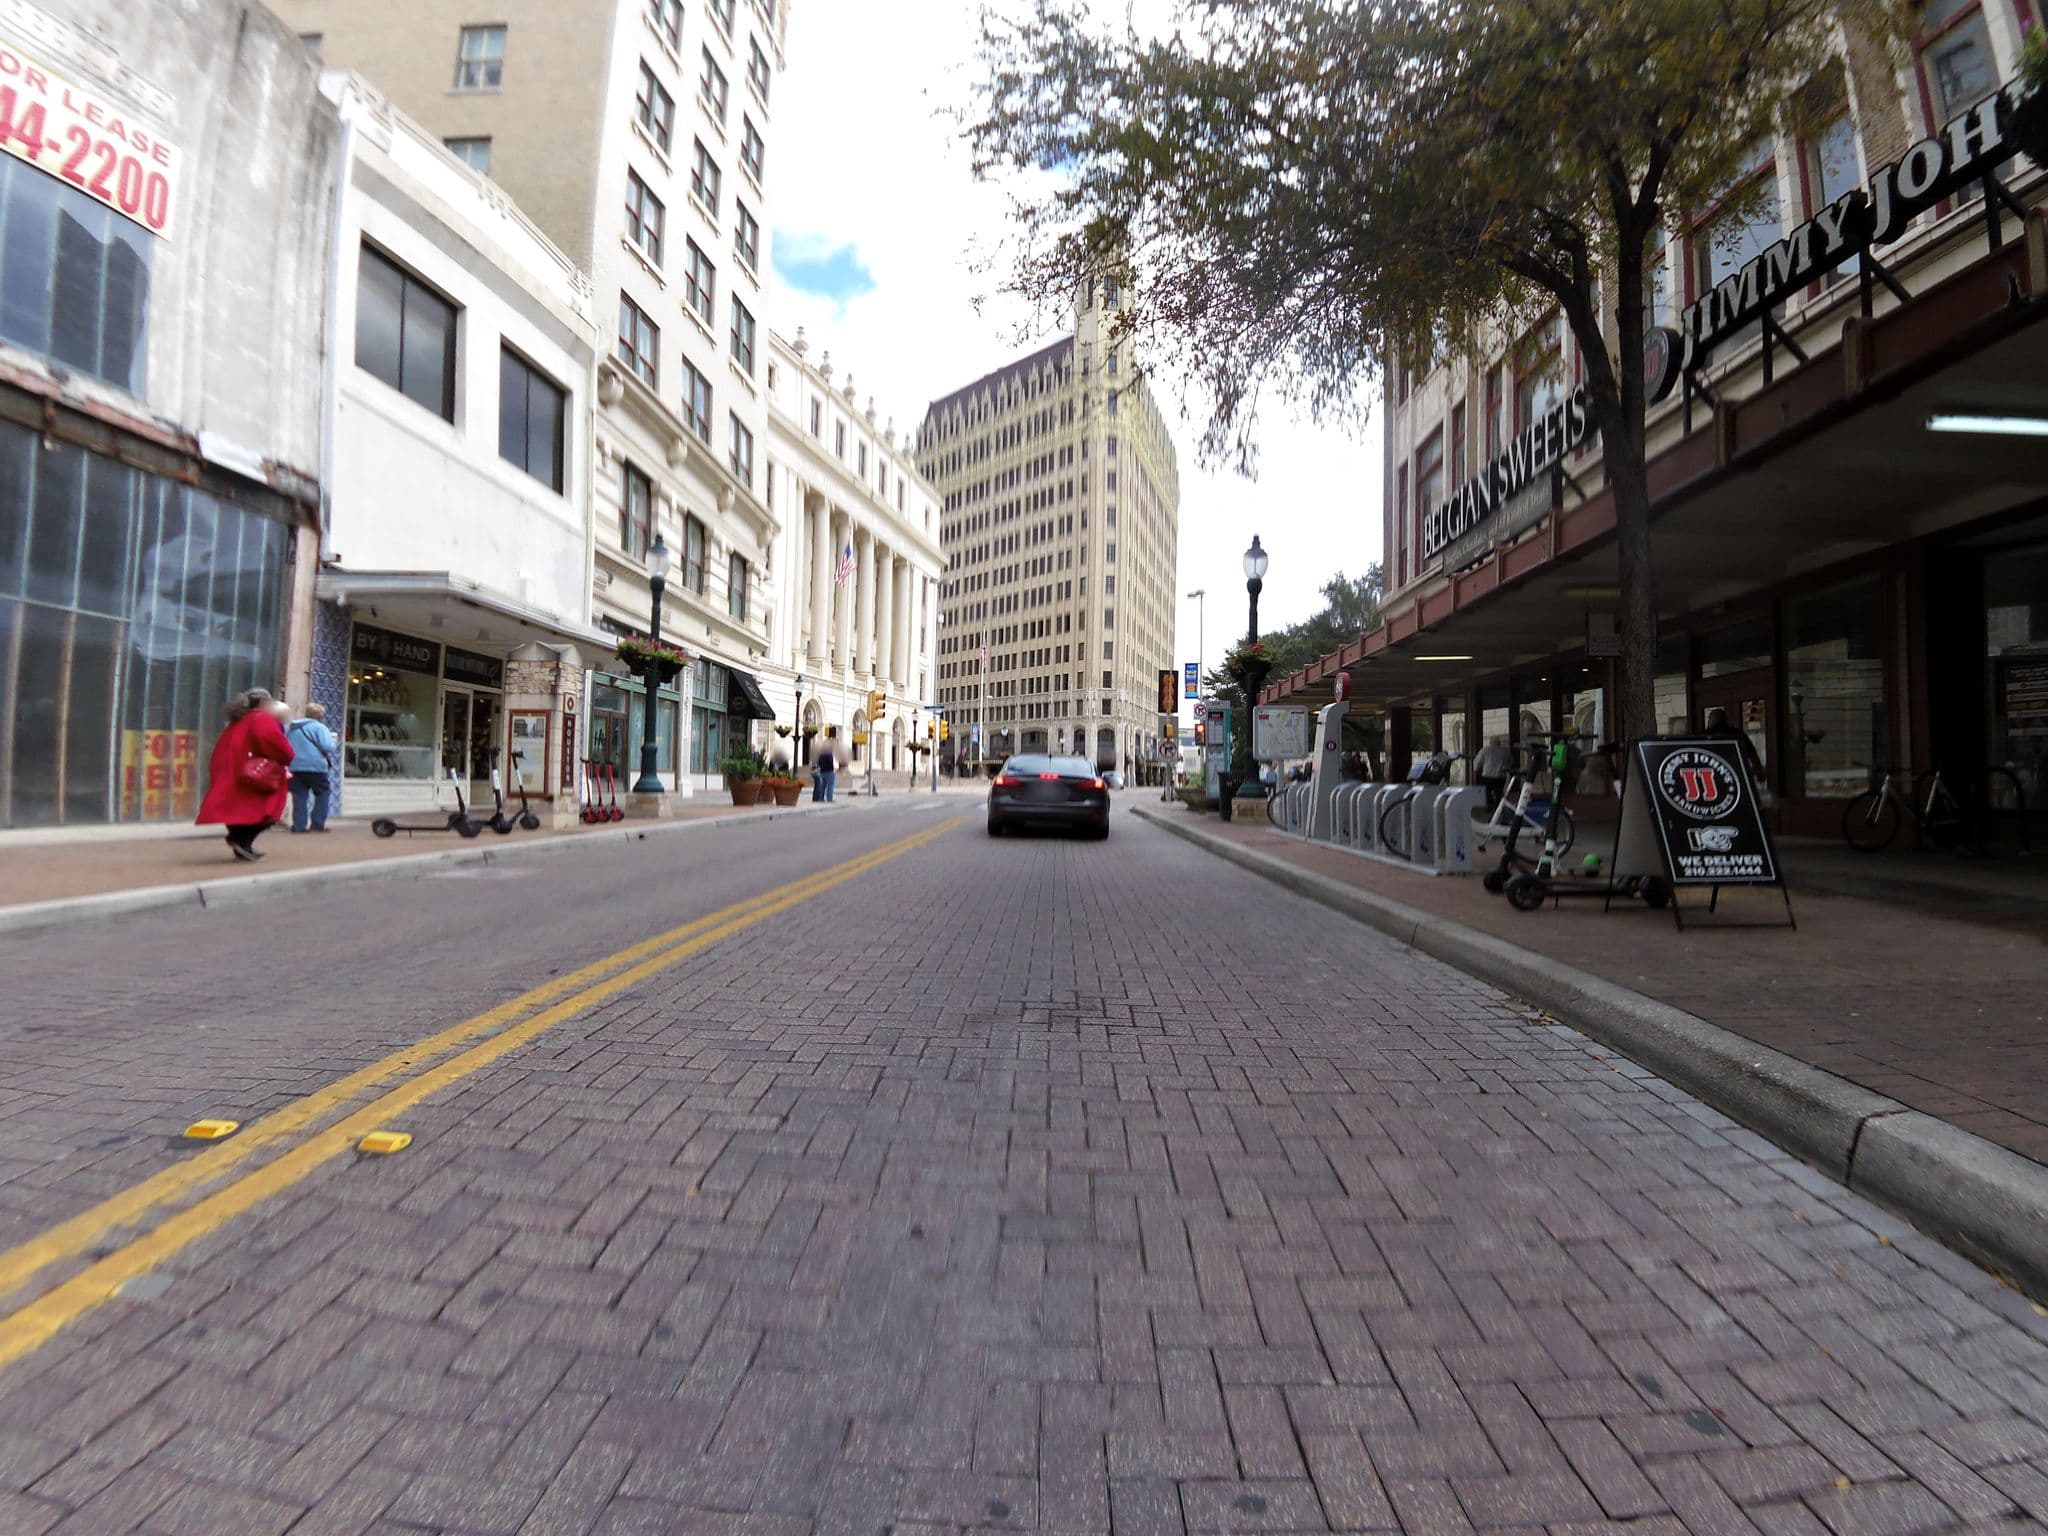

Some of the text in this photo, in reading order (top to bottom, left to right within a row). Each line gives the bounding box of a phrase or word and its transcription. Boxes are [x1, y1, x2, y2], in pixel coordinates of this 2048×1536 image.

[61, 88, 171, 168] LEASE
[1681, 193, 1851, 370] JIMMY
[1423, 457, 1492, 560] BELGIAN
[1497, 383, 1586, 504] SWEETS
[356, 632, 431, 662] BY HAND
[1678, 855, 1763, 867] WE DELIVER
